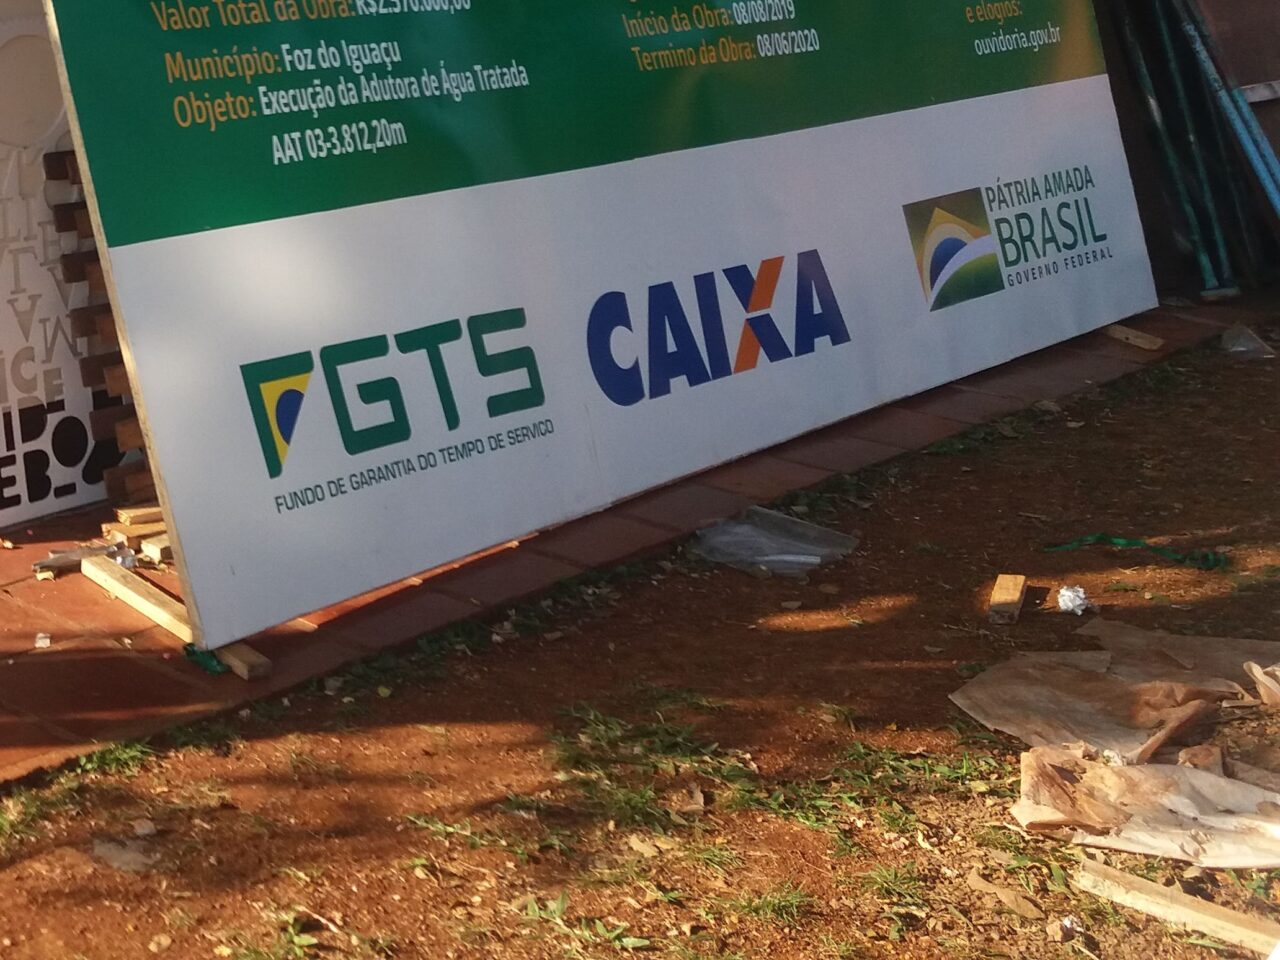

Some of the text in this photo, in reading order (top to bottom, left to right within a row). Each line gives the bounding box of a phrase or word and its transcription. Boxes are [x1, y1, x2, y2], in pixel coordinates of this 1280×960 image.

[622, 9, 669, 38] Início
[671, 9, 691, 32] da
[692, 3, 733, 29] Obra:
[965, 6, 975, 23] e
[974, 21, 1061, 55] ouvidoria.gov.br
[164, 39, 401, 85] Município: Foz do Iguaçu
[631, 28, 820, 71] Termino da Obra: 08/06/2020
[173, 59, 530, 132] Objeto: Execução da Adutora de Água Tratada
[271, 118, 408, 166] AAT 03-3.812,20m
[984, 165, 1095, 212] PÁTRIA AMADA
[995, 197, 1108, 268] BRASIL
[1007, 246, 1114, 287] GOVERNO FEDERAL
[587, 249, 851, 406] CAIXA
[239, 307, 545, 478] FGTS
[274, 485, 326, 514] FUNDO
[326, 480, 347, 498] DE
[349, 459, 416, 492] GARANTIA
[417, 451, 438, 471] DO
[439, 439, 485, 465] TEMPO
[488, 434, 505, 452] DE
